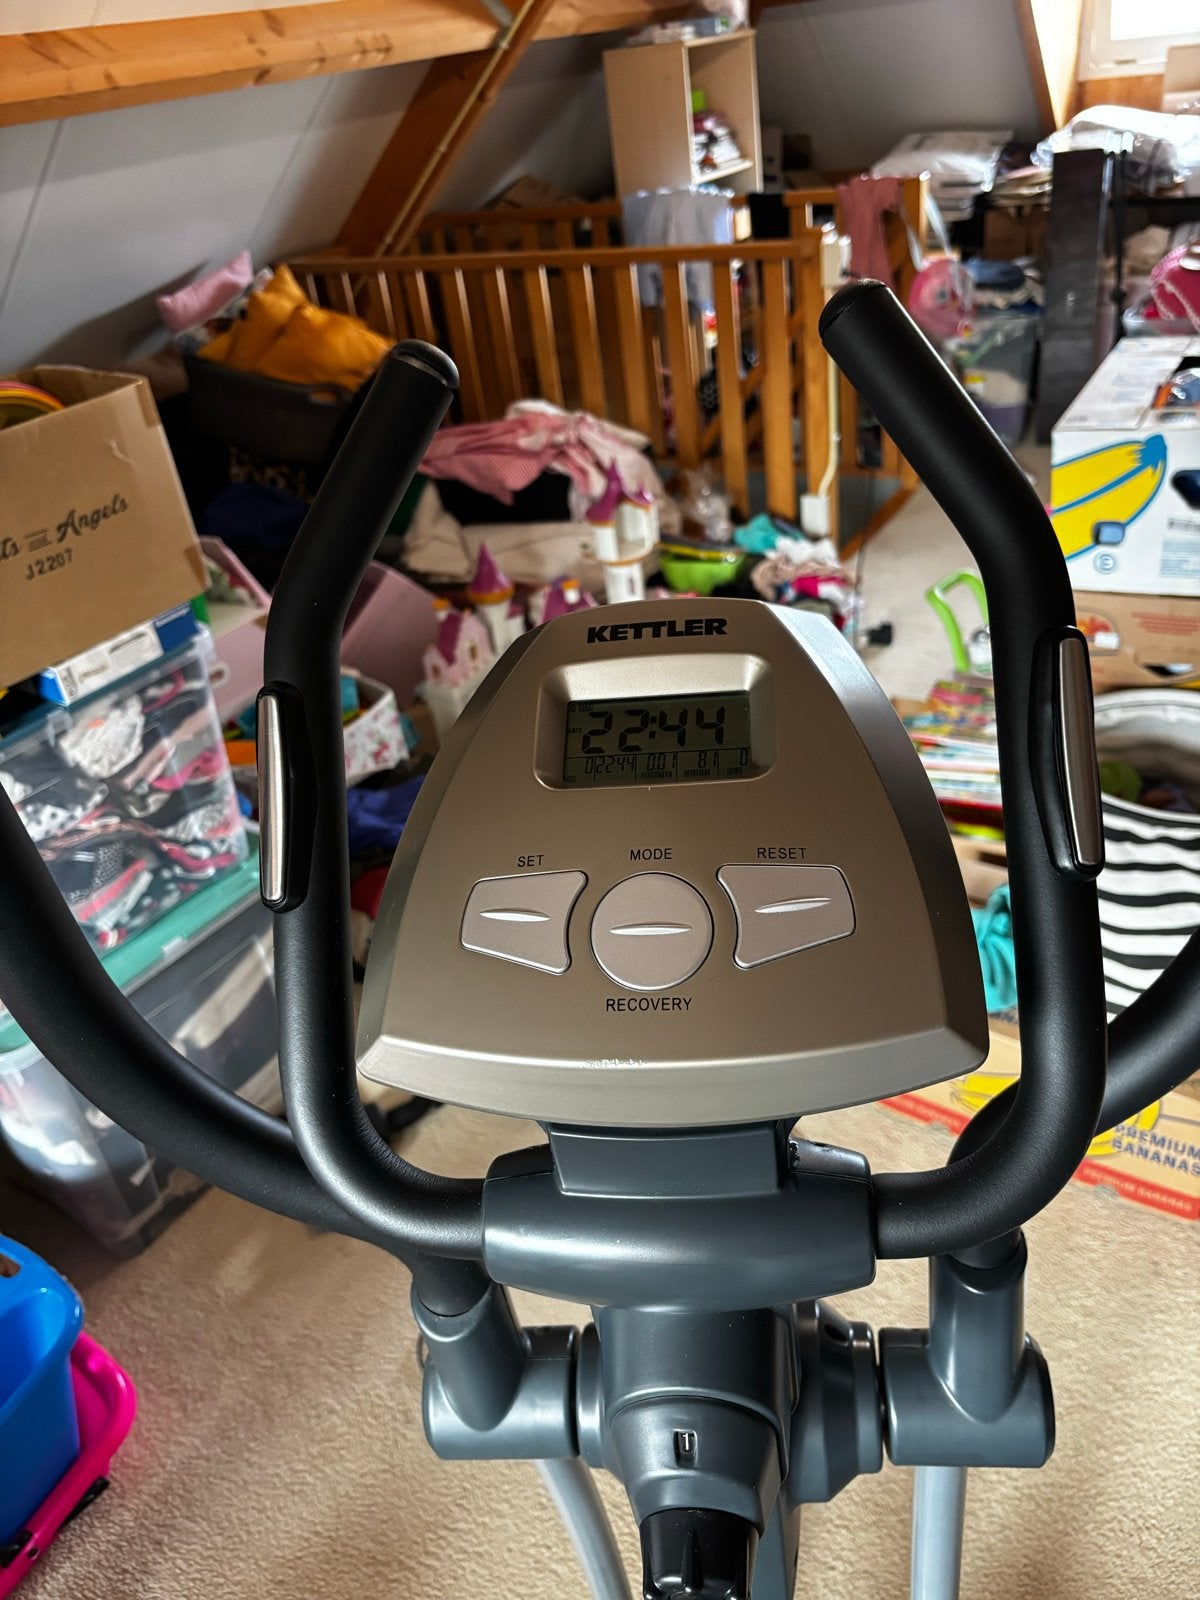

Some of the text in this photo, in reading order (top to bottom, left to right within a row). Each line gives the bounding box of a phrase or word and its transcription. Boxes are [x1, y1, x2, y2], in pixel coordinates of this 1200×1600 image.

[56, 493, 128, 543] Angels
[25, 548, 73, 580] J2207
[587, 618, 728, 643] KETTLER
[582, 706, 725, 754] 22:44
[517, 854, 545, 868] SET
[630, 848, 673, 861] MODE
[757, 847, 807, 859] RESET
[606, 997, 692, 1012] RECOVERY
[1115, 1124, 1200, 1160] PREMIUM
[1112, 1137, 1200, 1176] BANANAS
